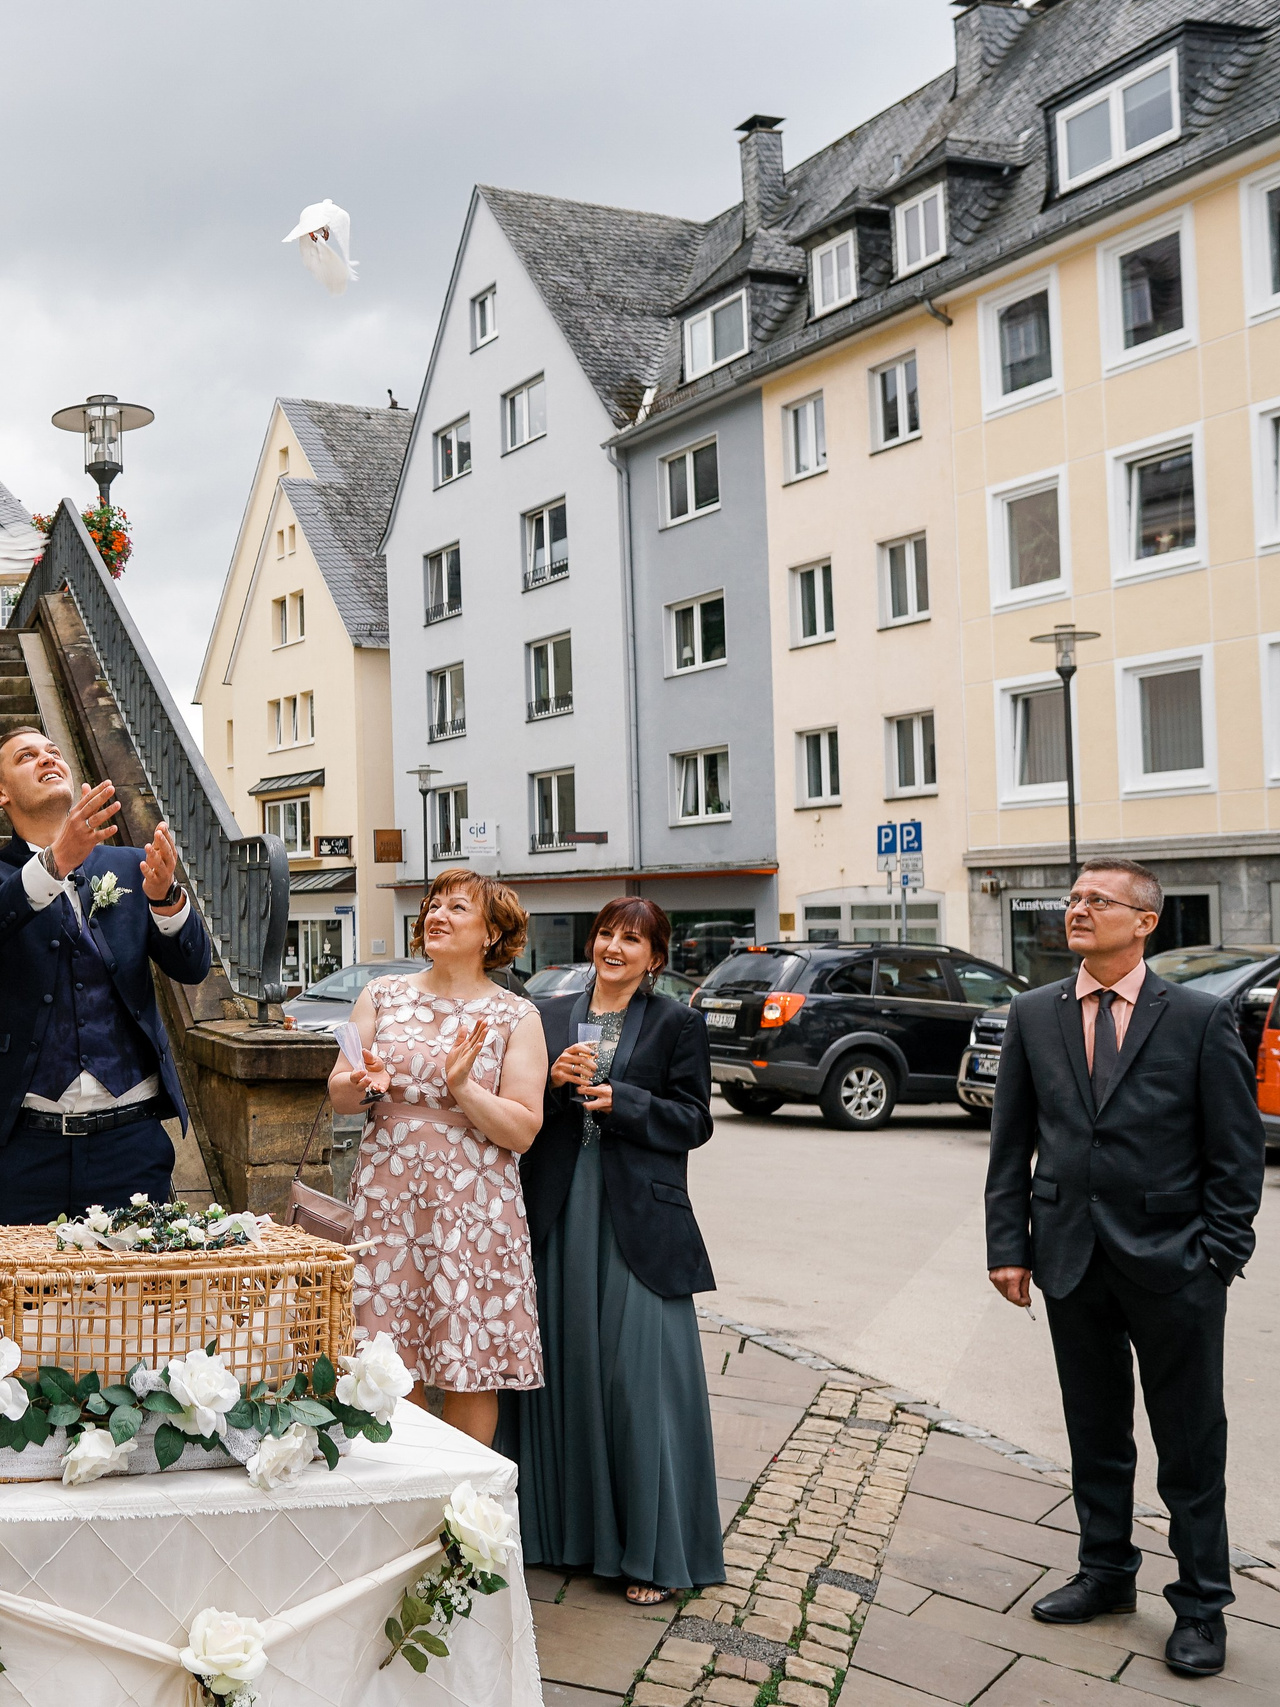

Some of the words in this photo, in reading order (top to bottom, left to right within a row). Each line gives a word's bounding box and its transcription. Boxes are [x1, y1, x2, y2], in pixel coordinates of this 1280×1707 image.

[469, 822, 486, 838] cjd
[882, 828, 893, 852] P
[903, 826, 915, 850] P
[331, 838, 344, 849] Café
